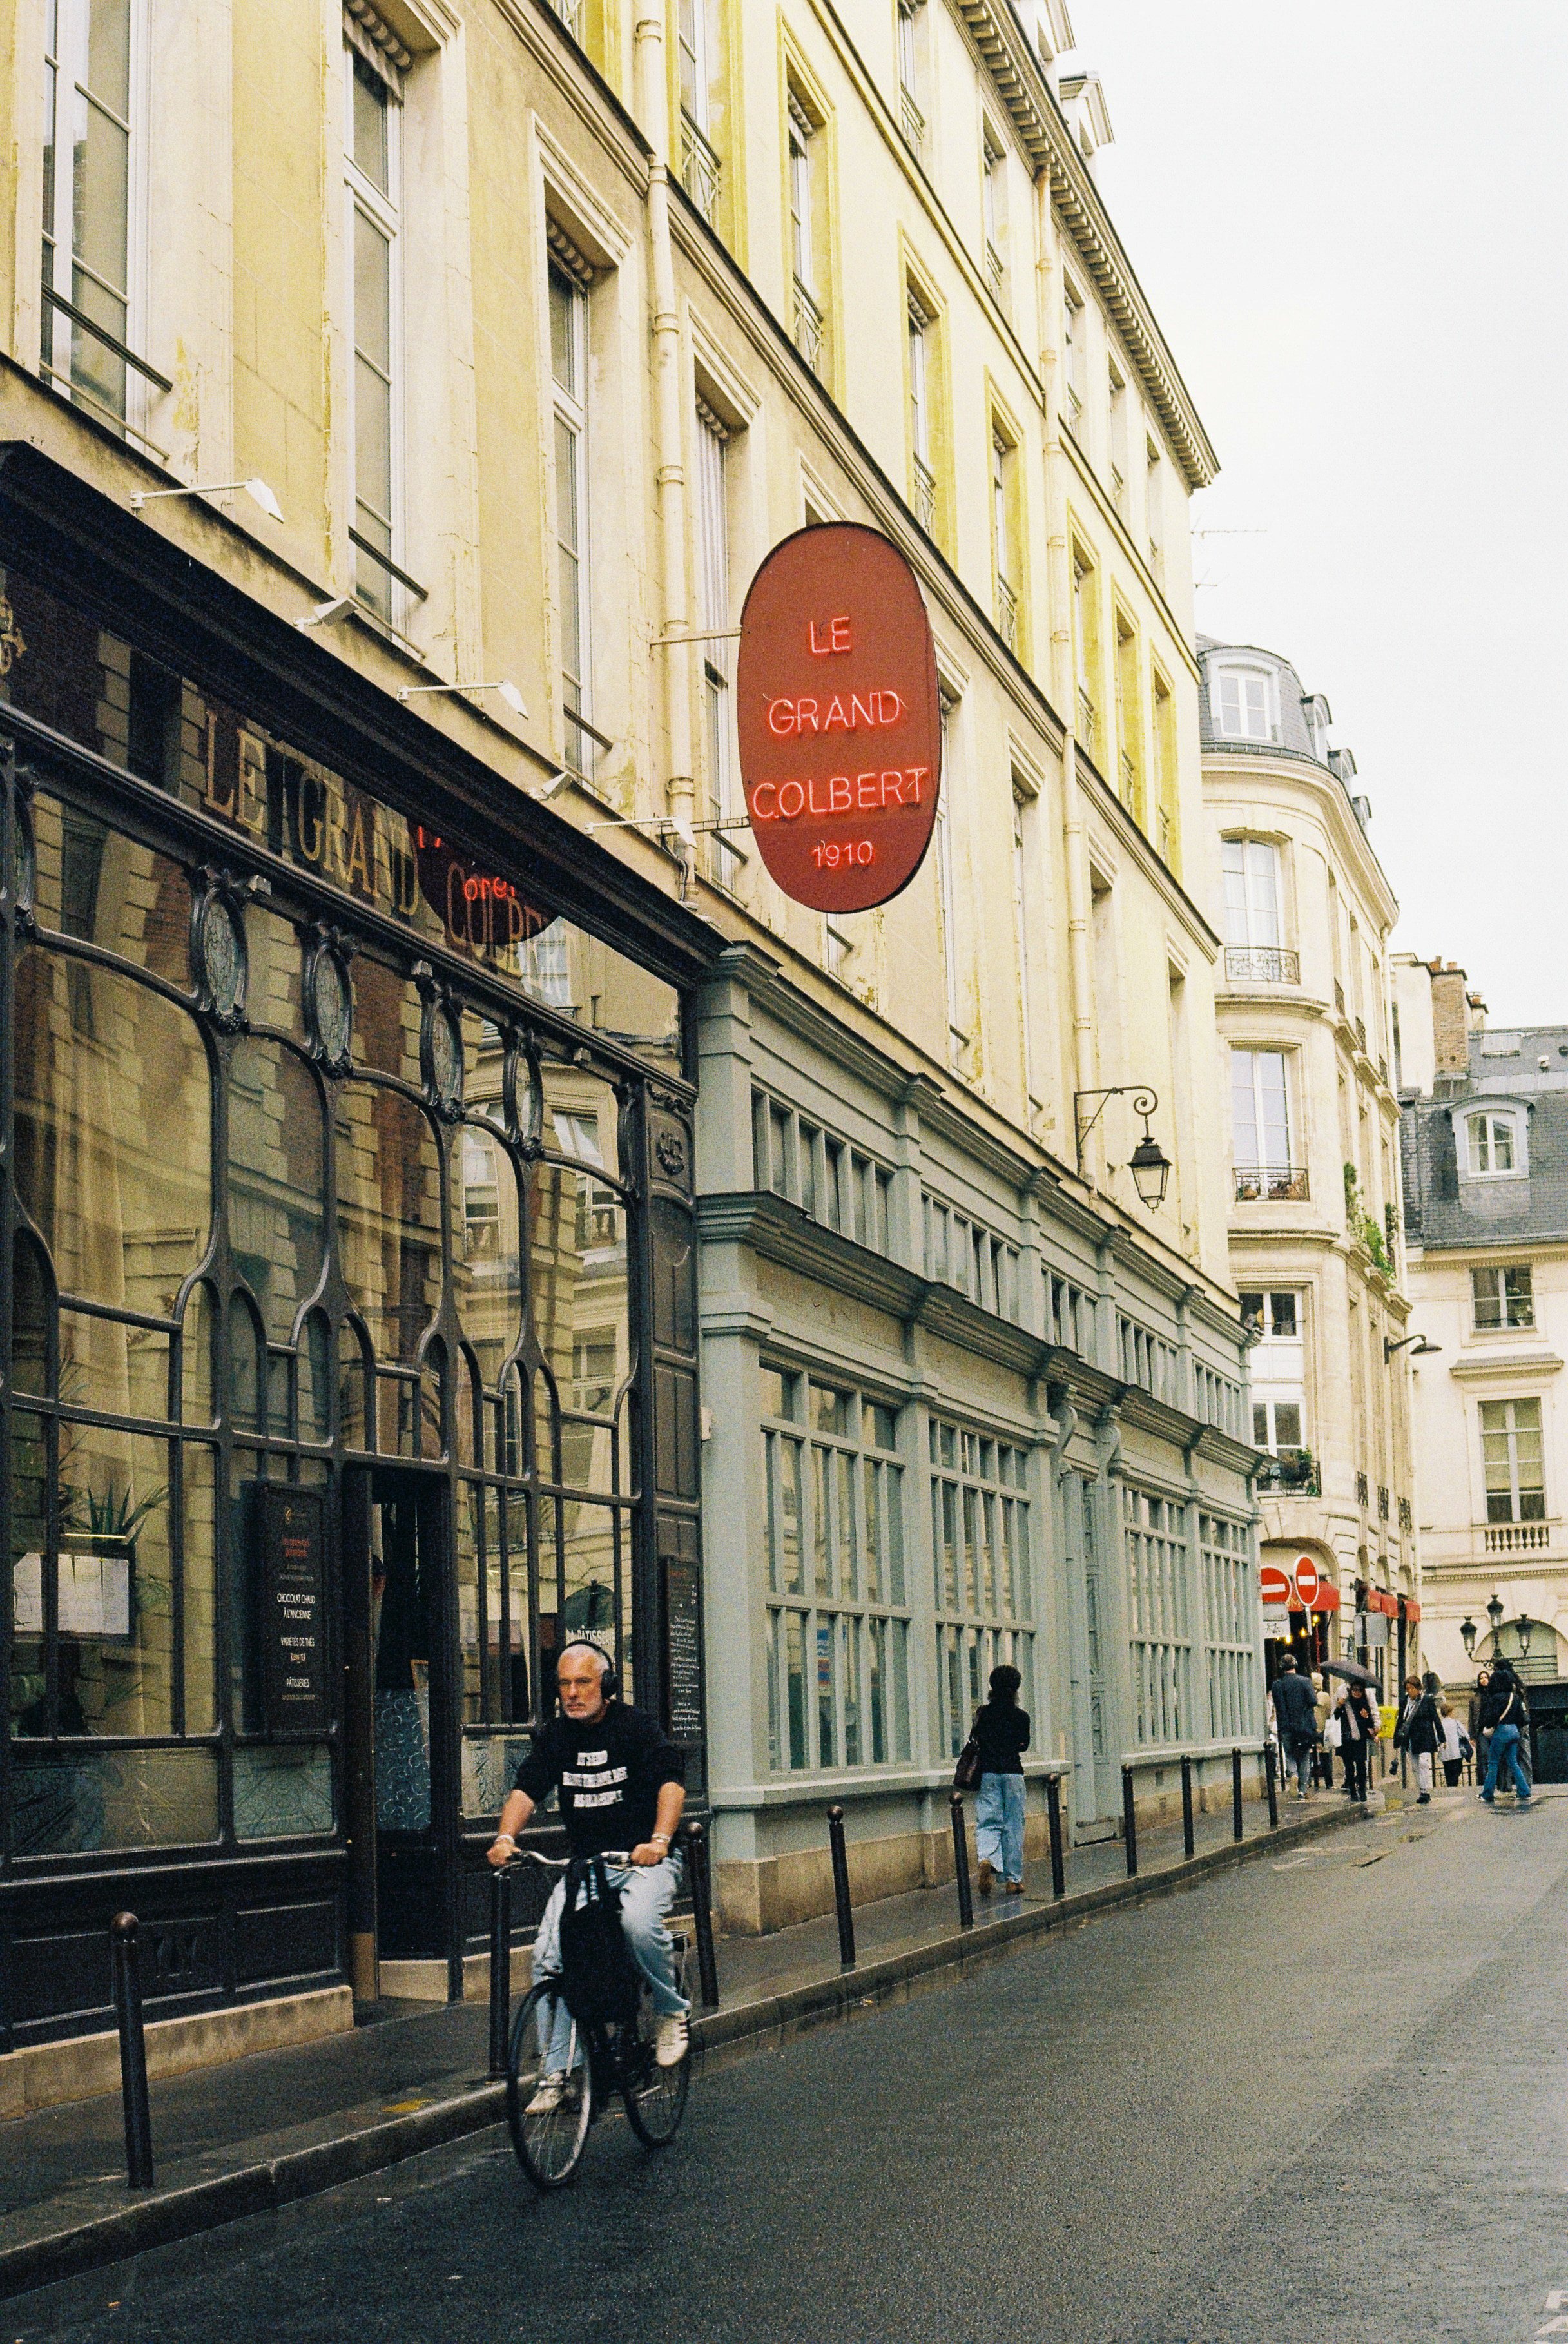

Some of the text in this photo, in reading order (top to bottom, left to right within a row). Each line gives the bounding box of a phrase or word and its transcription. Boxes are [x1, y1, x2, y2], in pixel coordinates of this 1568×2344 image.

[809, 617, 852, 654] LE
[769, 690, 901, 735] GRAND
[204, 710, 268, 835] LE
[298, 770, 420, 916] GRAND
[753, 768, 928, 818] COLBERT
[813, 841, 874, 866] 1910
